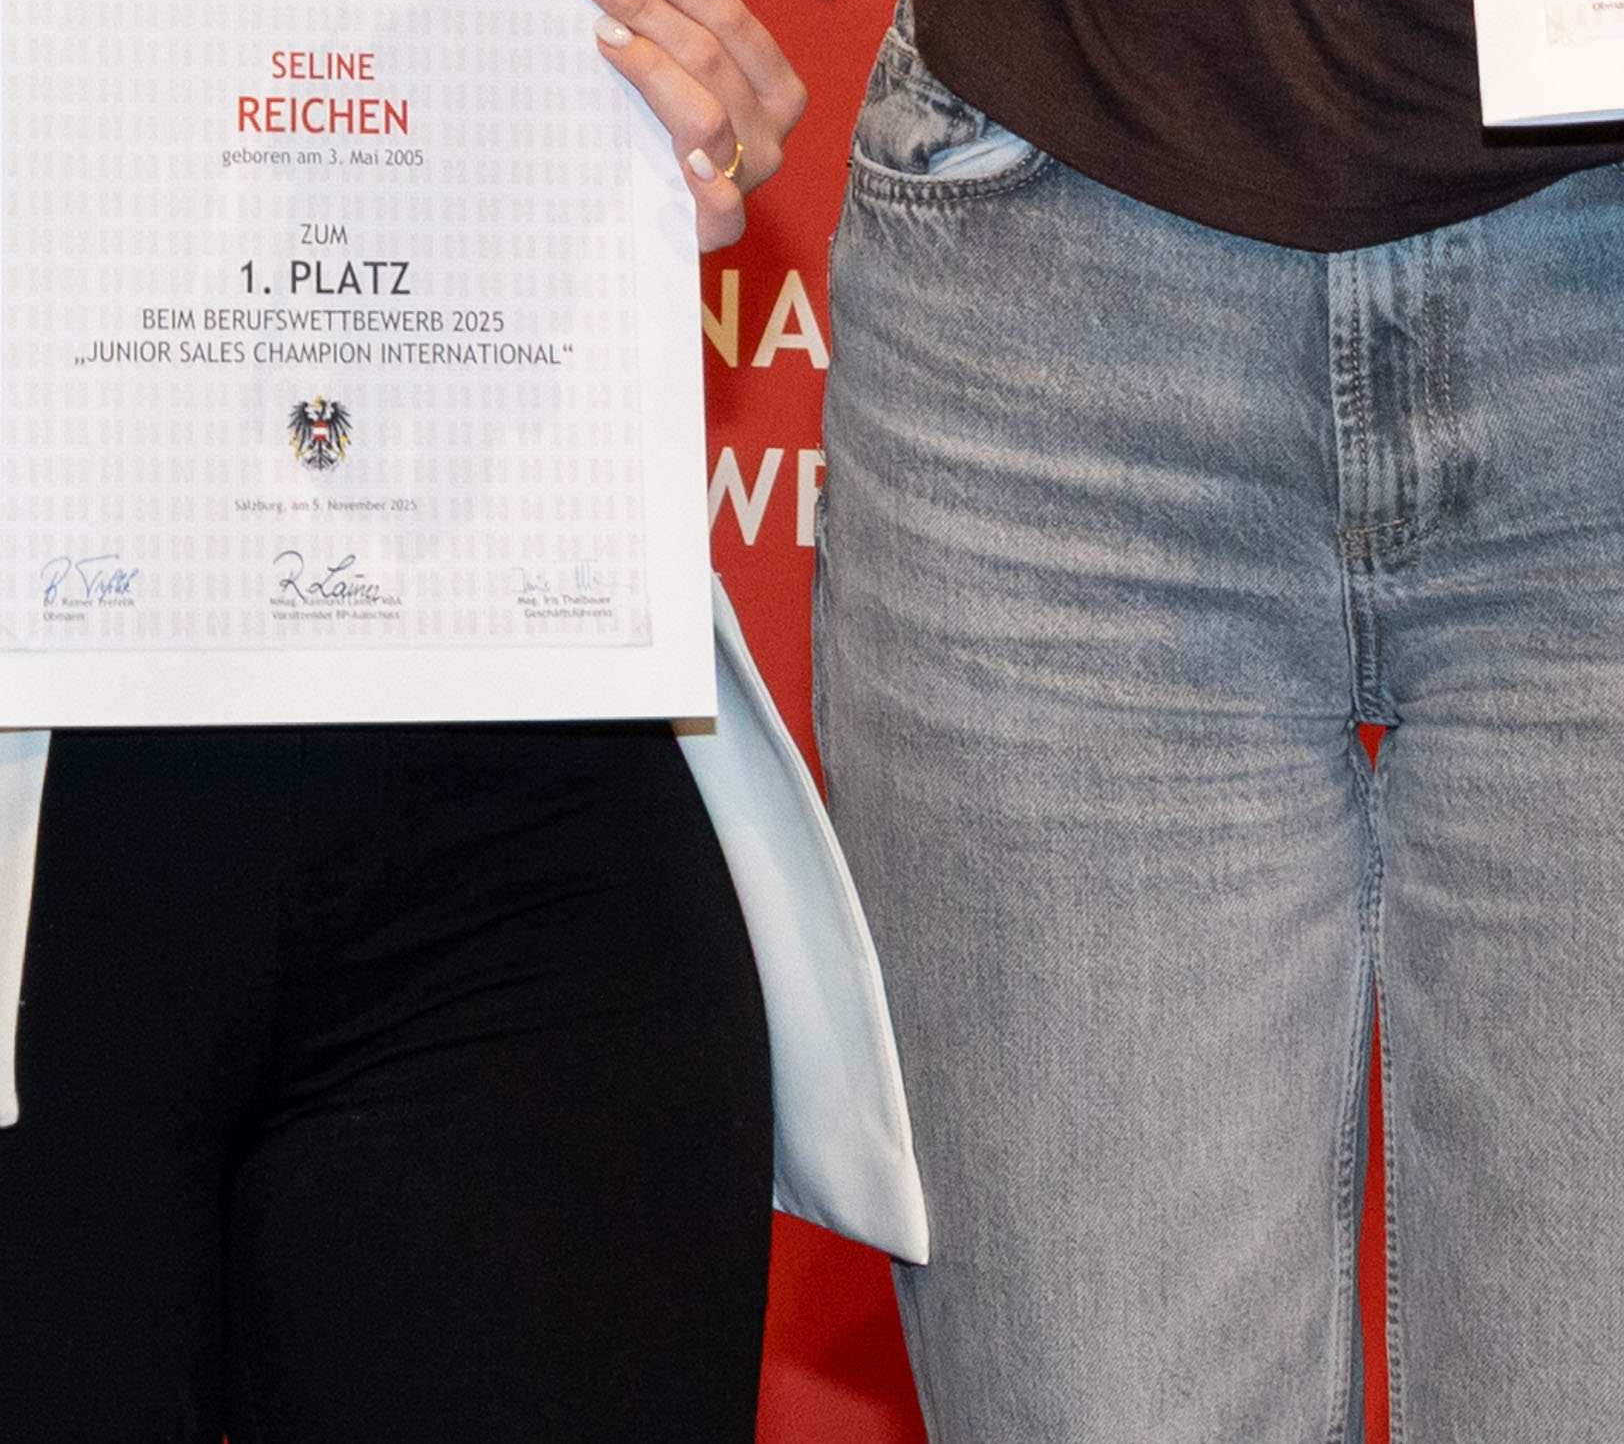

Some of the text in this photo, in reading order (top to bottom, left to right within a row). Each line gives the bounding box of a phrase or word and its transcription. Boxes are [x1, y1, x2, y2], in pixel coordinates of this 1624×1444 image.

[272, 51, 374, 81] SELINE
[238, 95, 407, 135] REICHEN
[222, 148, 424, 167] geboren am 3. Mai 2005
[301, 223, 348, 246] ZUM
[241, 260, 410, 295] 1. PLATZ
[143, 308, 504, 333] BEIM BERUFSWETTBEWERB 2025
[180, 341, 245, 364] SALES
[253, 341, 371, 364] CHAMPION
